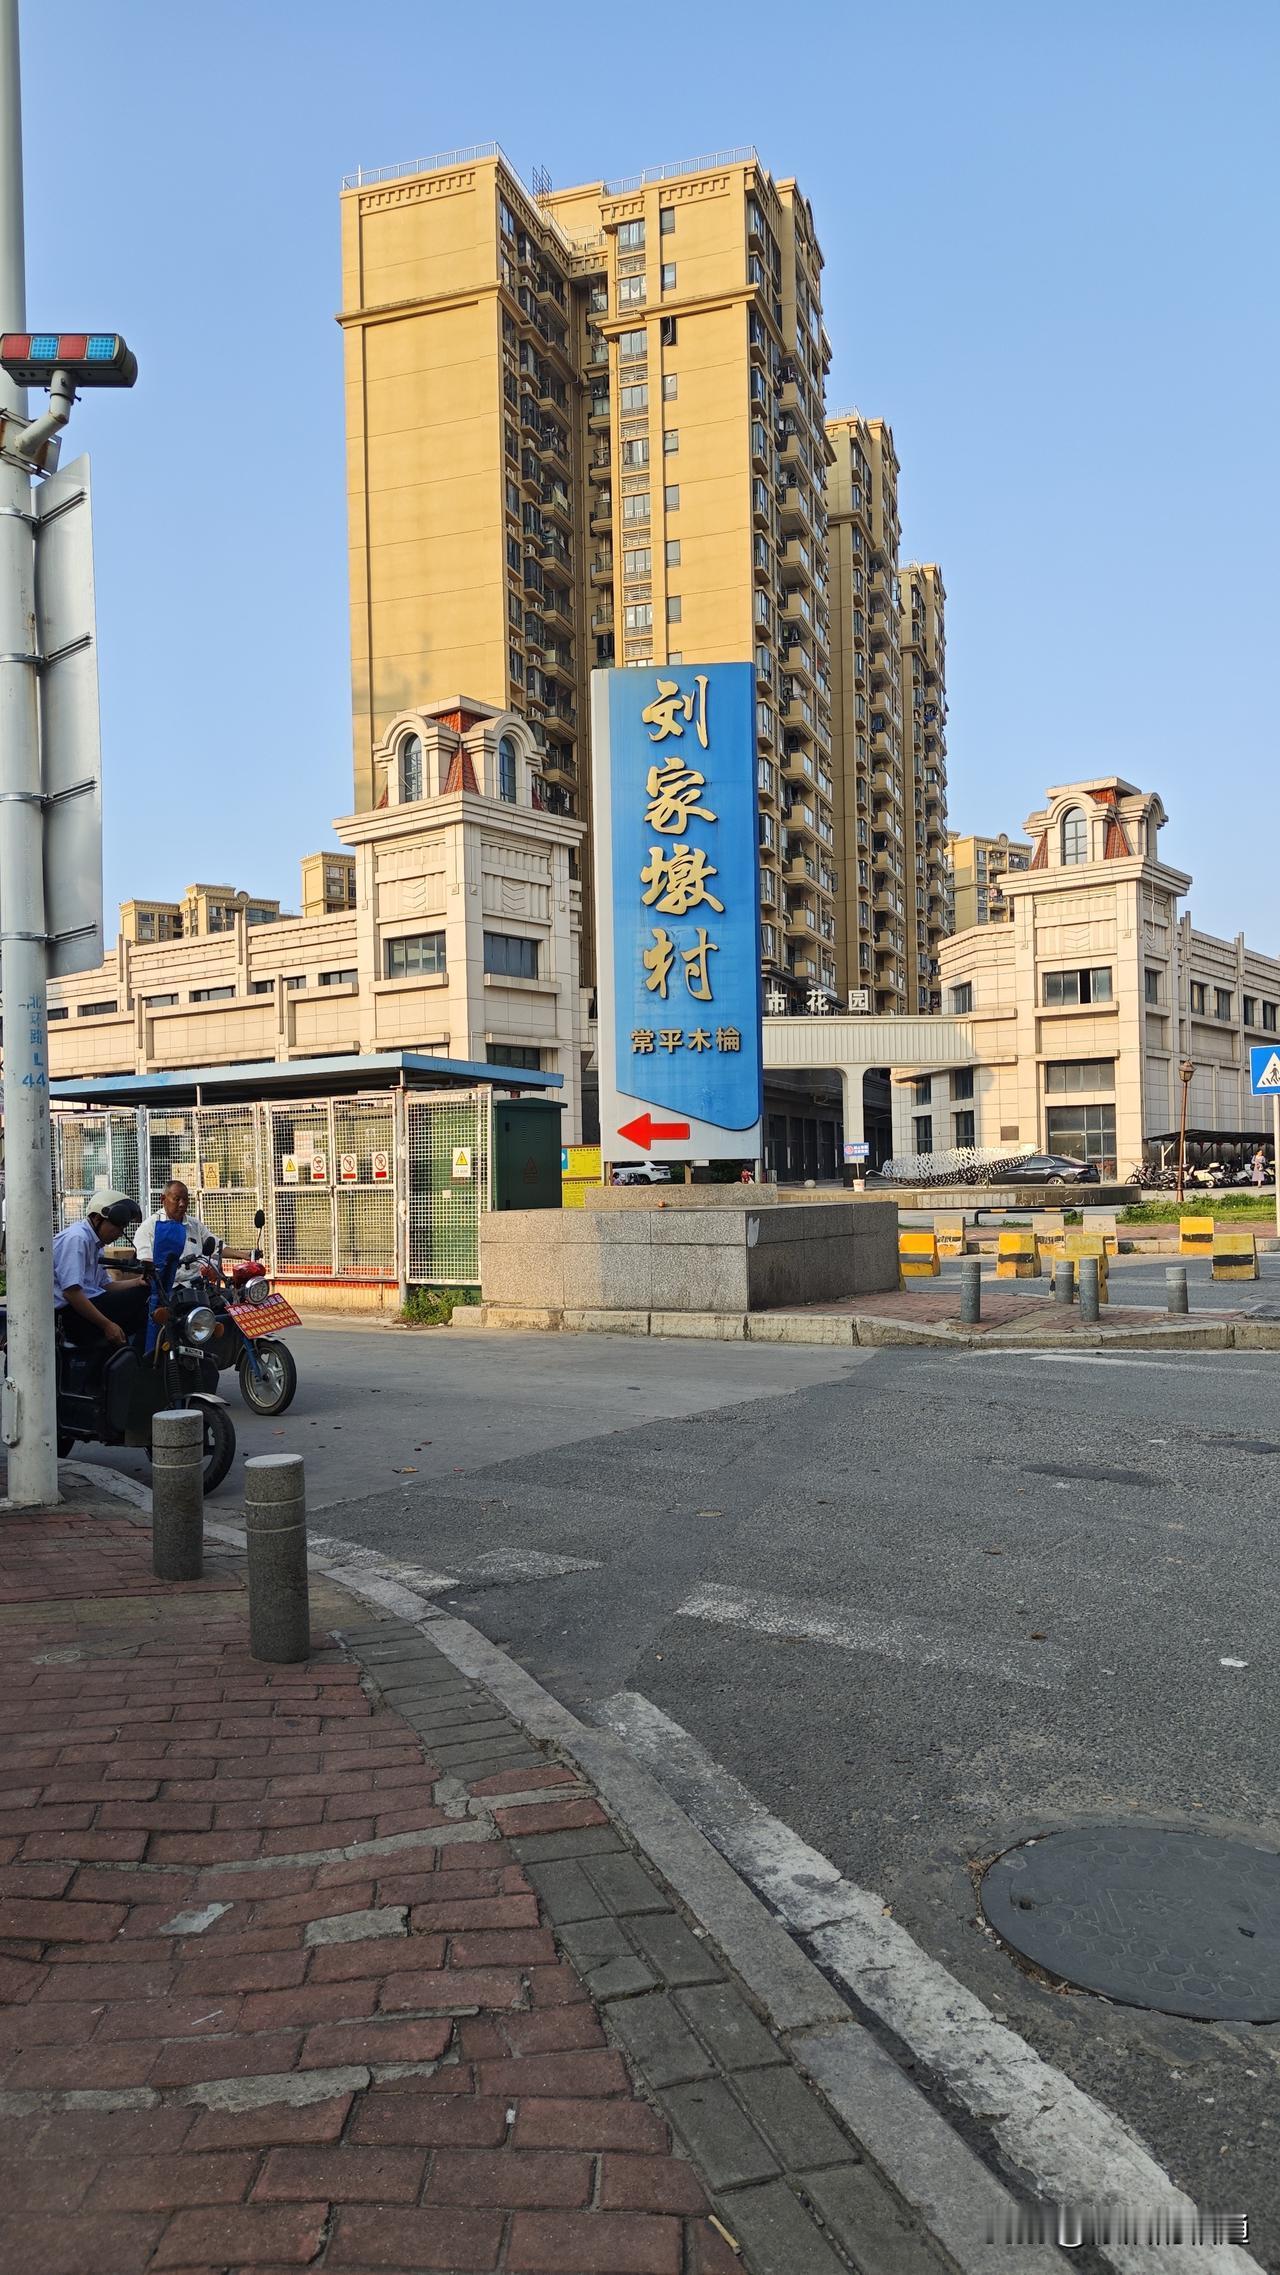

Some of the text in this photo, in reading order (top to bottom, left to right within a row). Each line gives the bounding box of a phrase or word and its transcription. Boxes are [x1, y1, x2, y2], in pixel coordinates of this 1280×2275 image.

[641, 675, 725, 1001] 刘家墩村
[765, 989, 869, 1013] 市花园
[22, 1072, 46, 1088] 44
